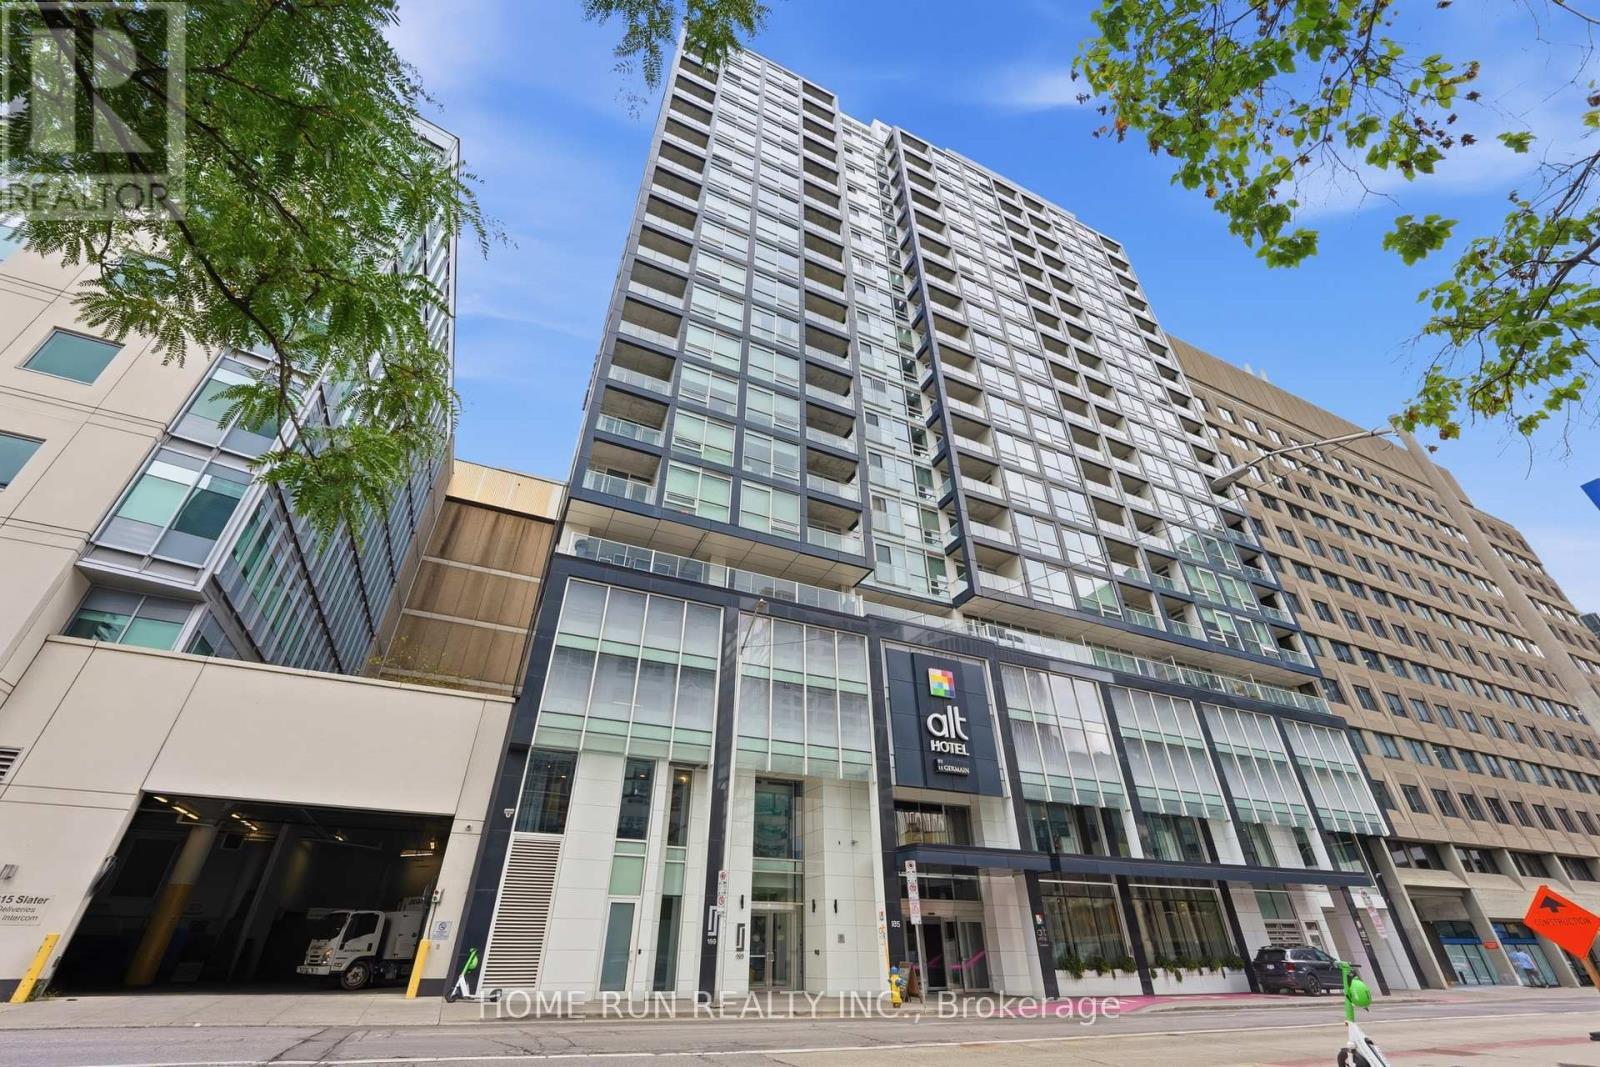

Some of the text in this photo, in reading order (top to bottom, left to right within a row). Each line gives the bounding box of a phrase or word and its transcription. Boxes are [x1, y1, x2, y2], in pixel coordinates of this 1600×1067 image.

[926, 705, 969, 740] alt
[930, 739, 970, 756] HOTEL
[15, 895, 49, 905] Slater
